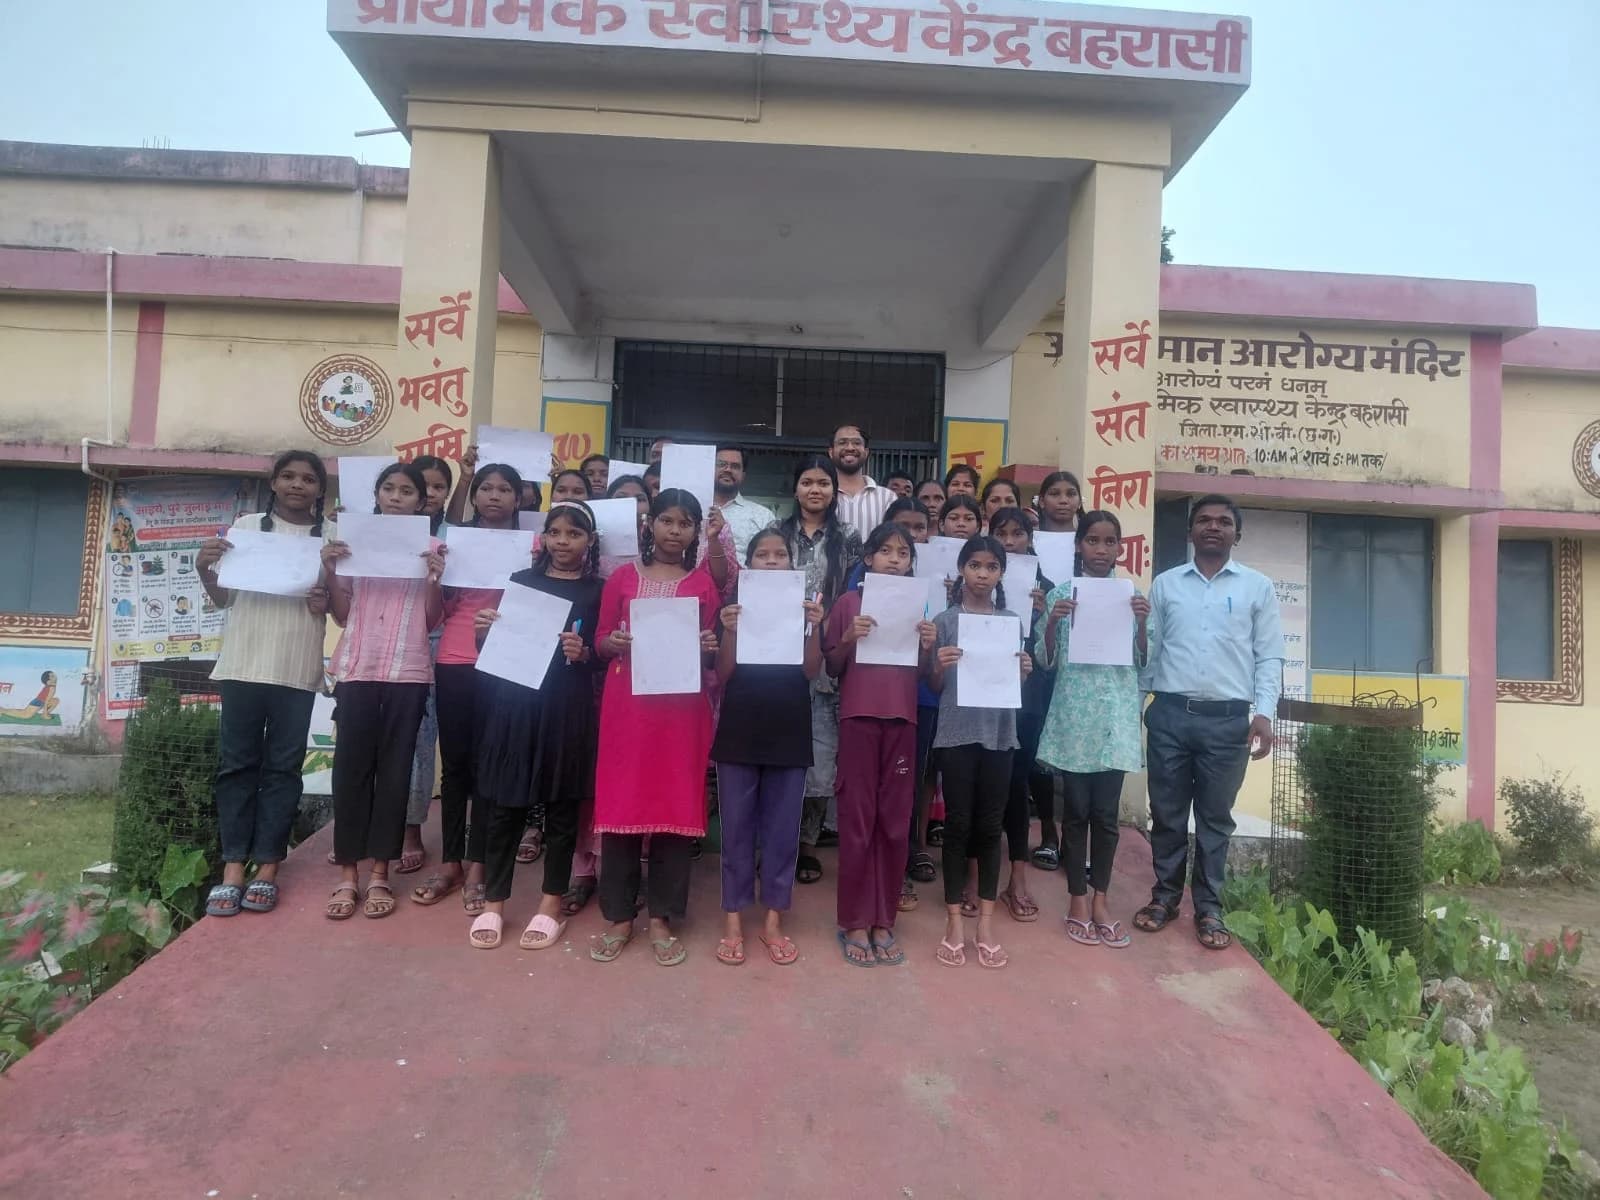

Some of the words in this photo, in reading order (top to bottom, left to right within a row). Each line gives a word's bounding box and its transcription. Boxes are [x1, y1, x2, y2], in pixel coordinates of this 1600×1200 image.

[920, 0, 1038, 67] केंद्र
[1044, 19, 1248, 74] बहरासी
[1230, 331, 1367, 373] आरोग्य
[1370, 338, 1466, 382] मंदिर
[399, 358, 470, 418] भवंतु
[1227, 372, 1272, 391] परमं
[1210, 397, 1300, 418] स्वास्थ्य
[1349, 398, 1410, 428] बहरासी
[1087, 465, 1152, 510] निरा
